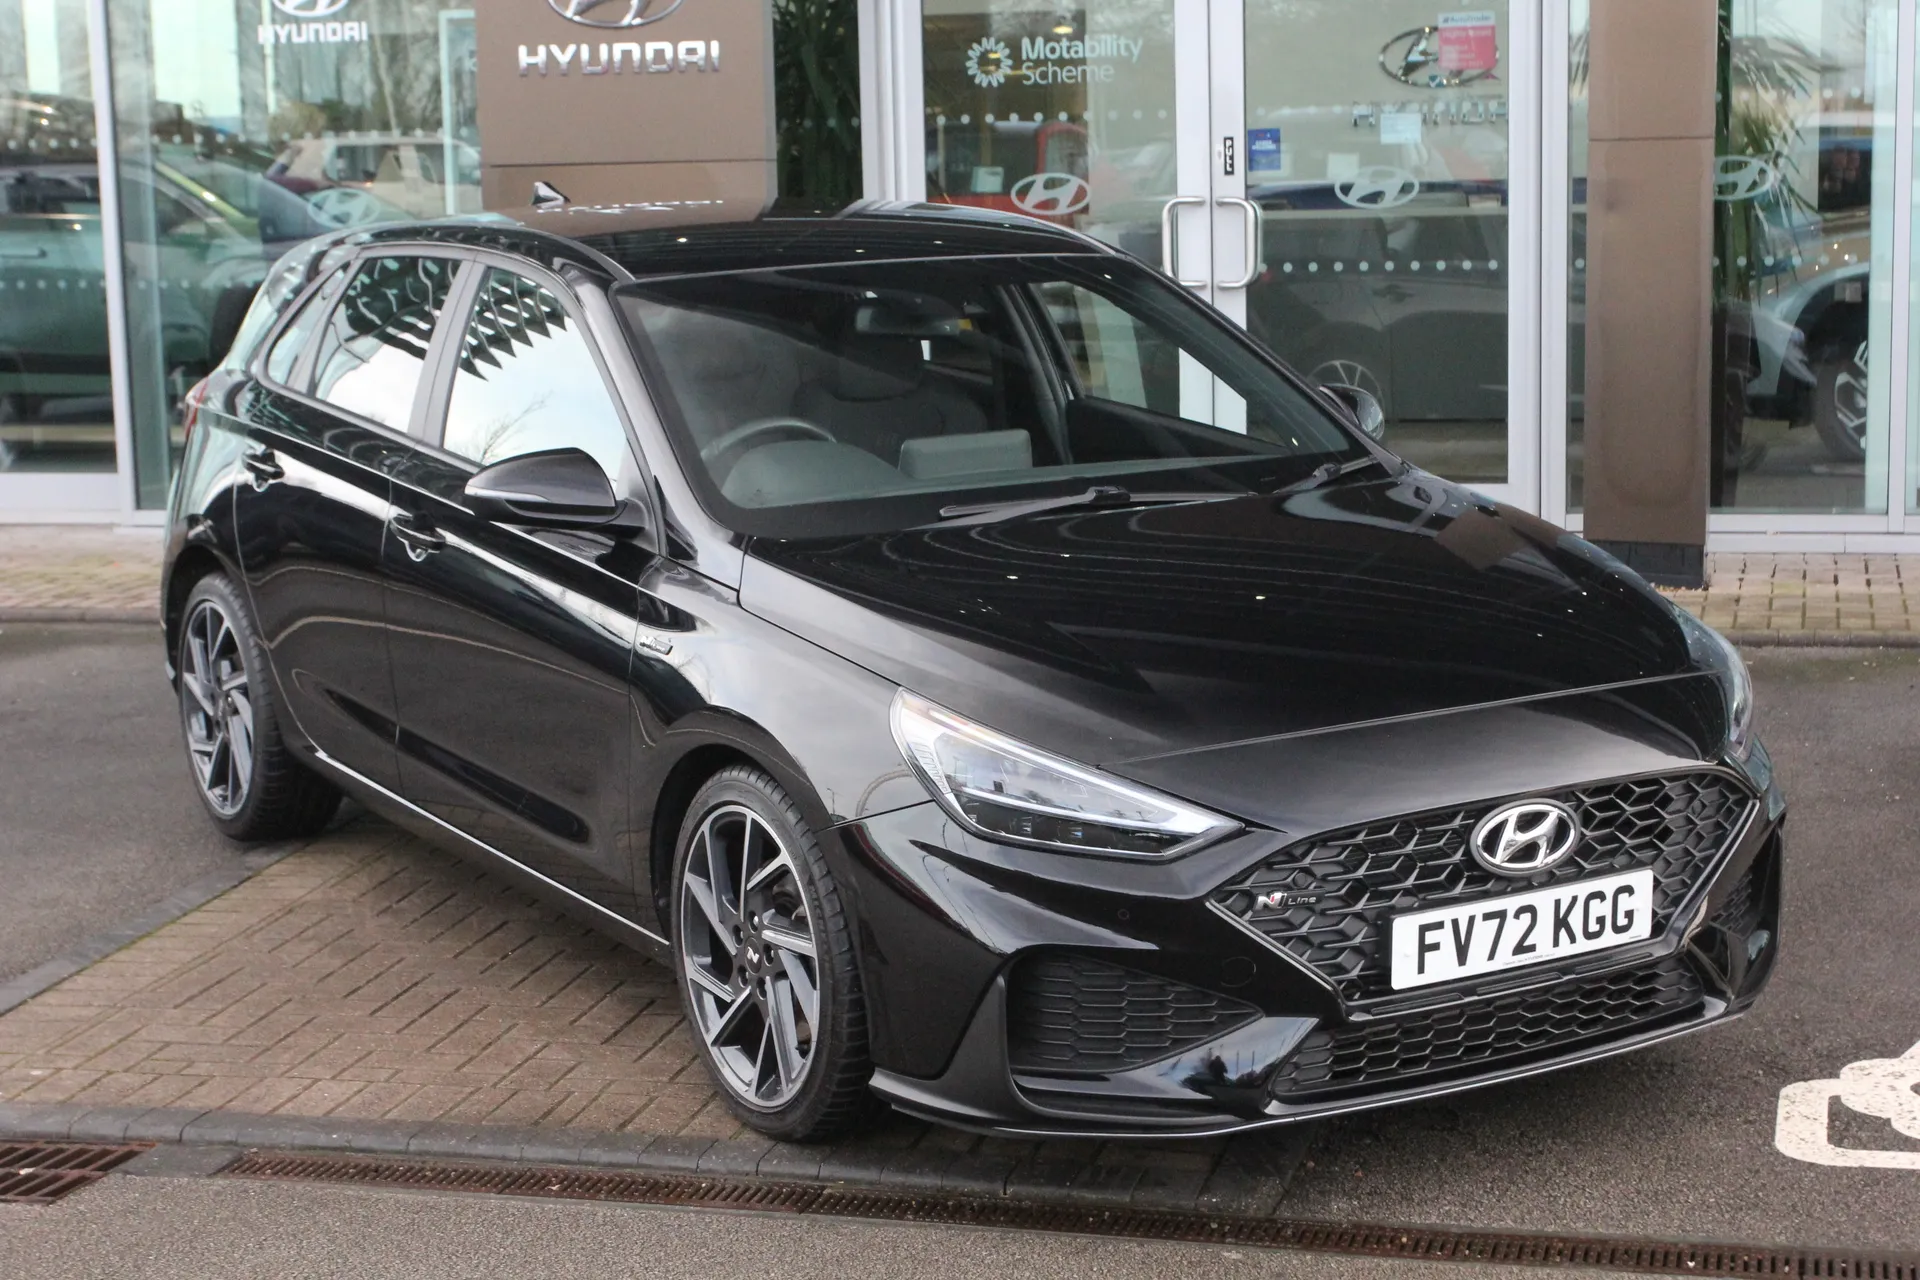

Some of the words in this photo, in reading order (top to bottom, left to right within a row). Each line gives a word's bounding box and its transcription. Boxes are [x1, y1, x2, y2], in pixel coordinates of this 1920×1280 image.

[257, 21, 368, 44] HYUNDAI
[518, 40, 720, 76] HYUNDAI
[1021, 35, 1143, 62] Motability
[1022, 62, 1115, 85] Scheme
[1417, 903, 1538, 975] FV72
[1552, 884, 1635, 948] KGG
